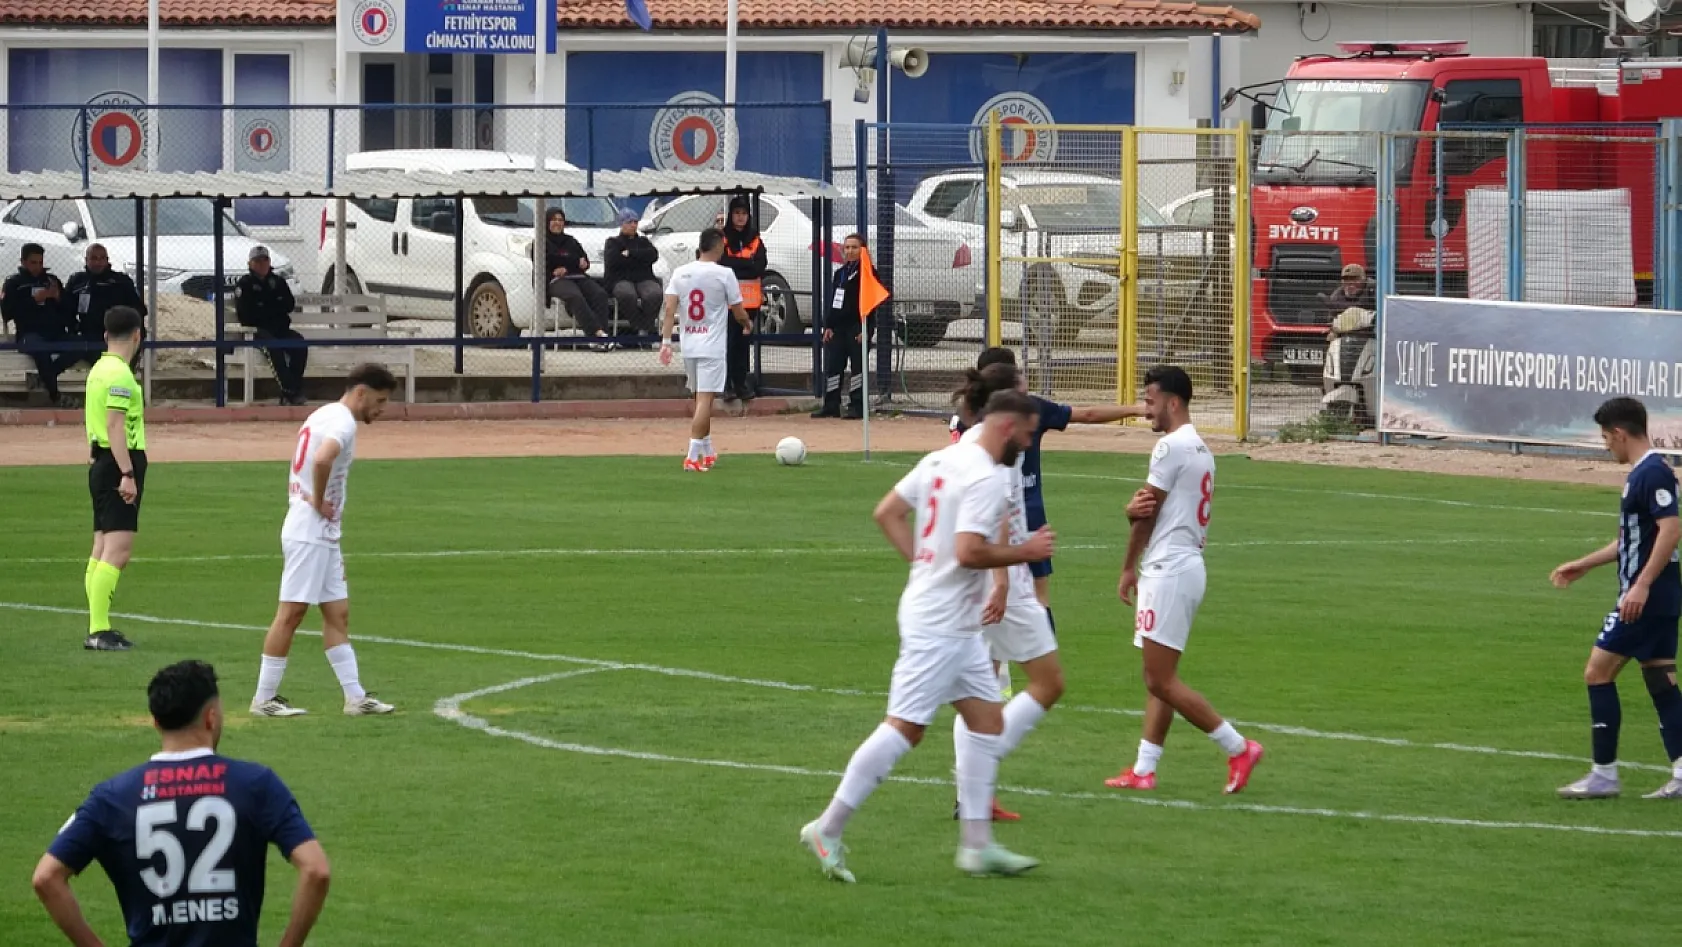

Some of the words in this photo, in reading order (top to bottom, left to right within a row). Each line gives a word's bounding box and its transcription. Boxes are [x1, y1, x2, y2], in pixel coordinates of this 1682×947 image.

[445, 13, 516, 30] FETHİYESPOR
[426, 30, 487, 49] CİMNASTİK
[489, 34, 535, 49] SALONU
[688, 288, 705, 321] 8
[1448, 344, 1571, 391] FETHİYESPOR'A
[1576, 355, 1668, 398] BAŞARILAR
[144, 764, 226, 785] ESNAF
[136, 796, 237, 898] 52
